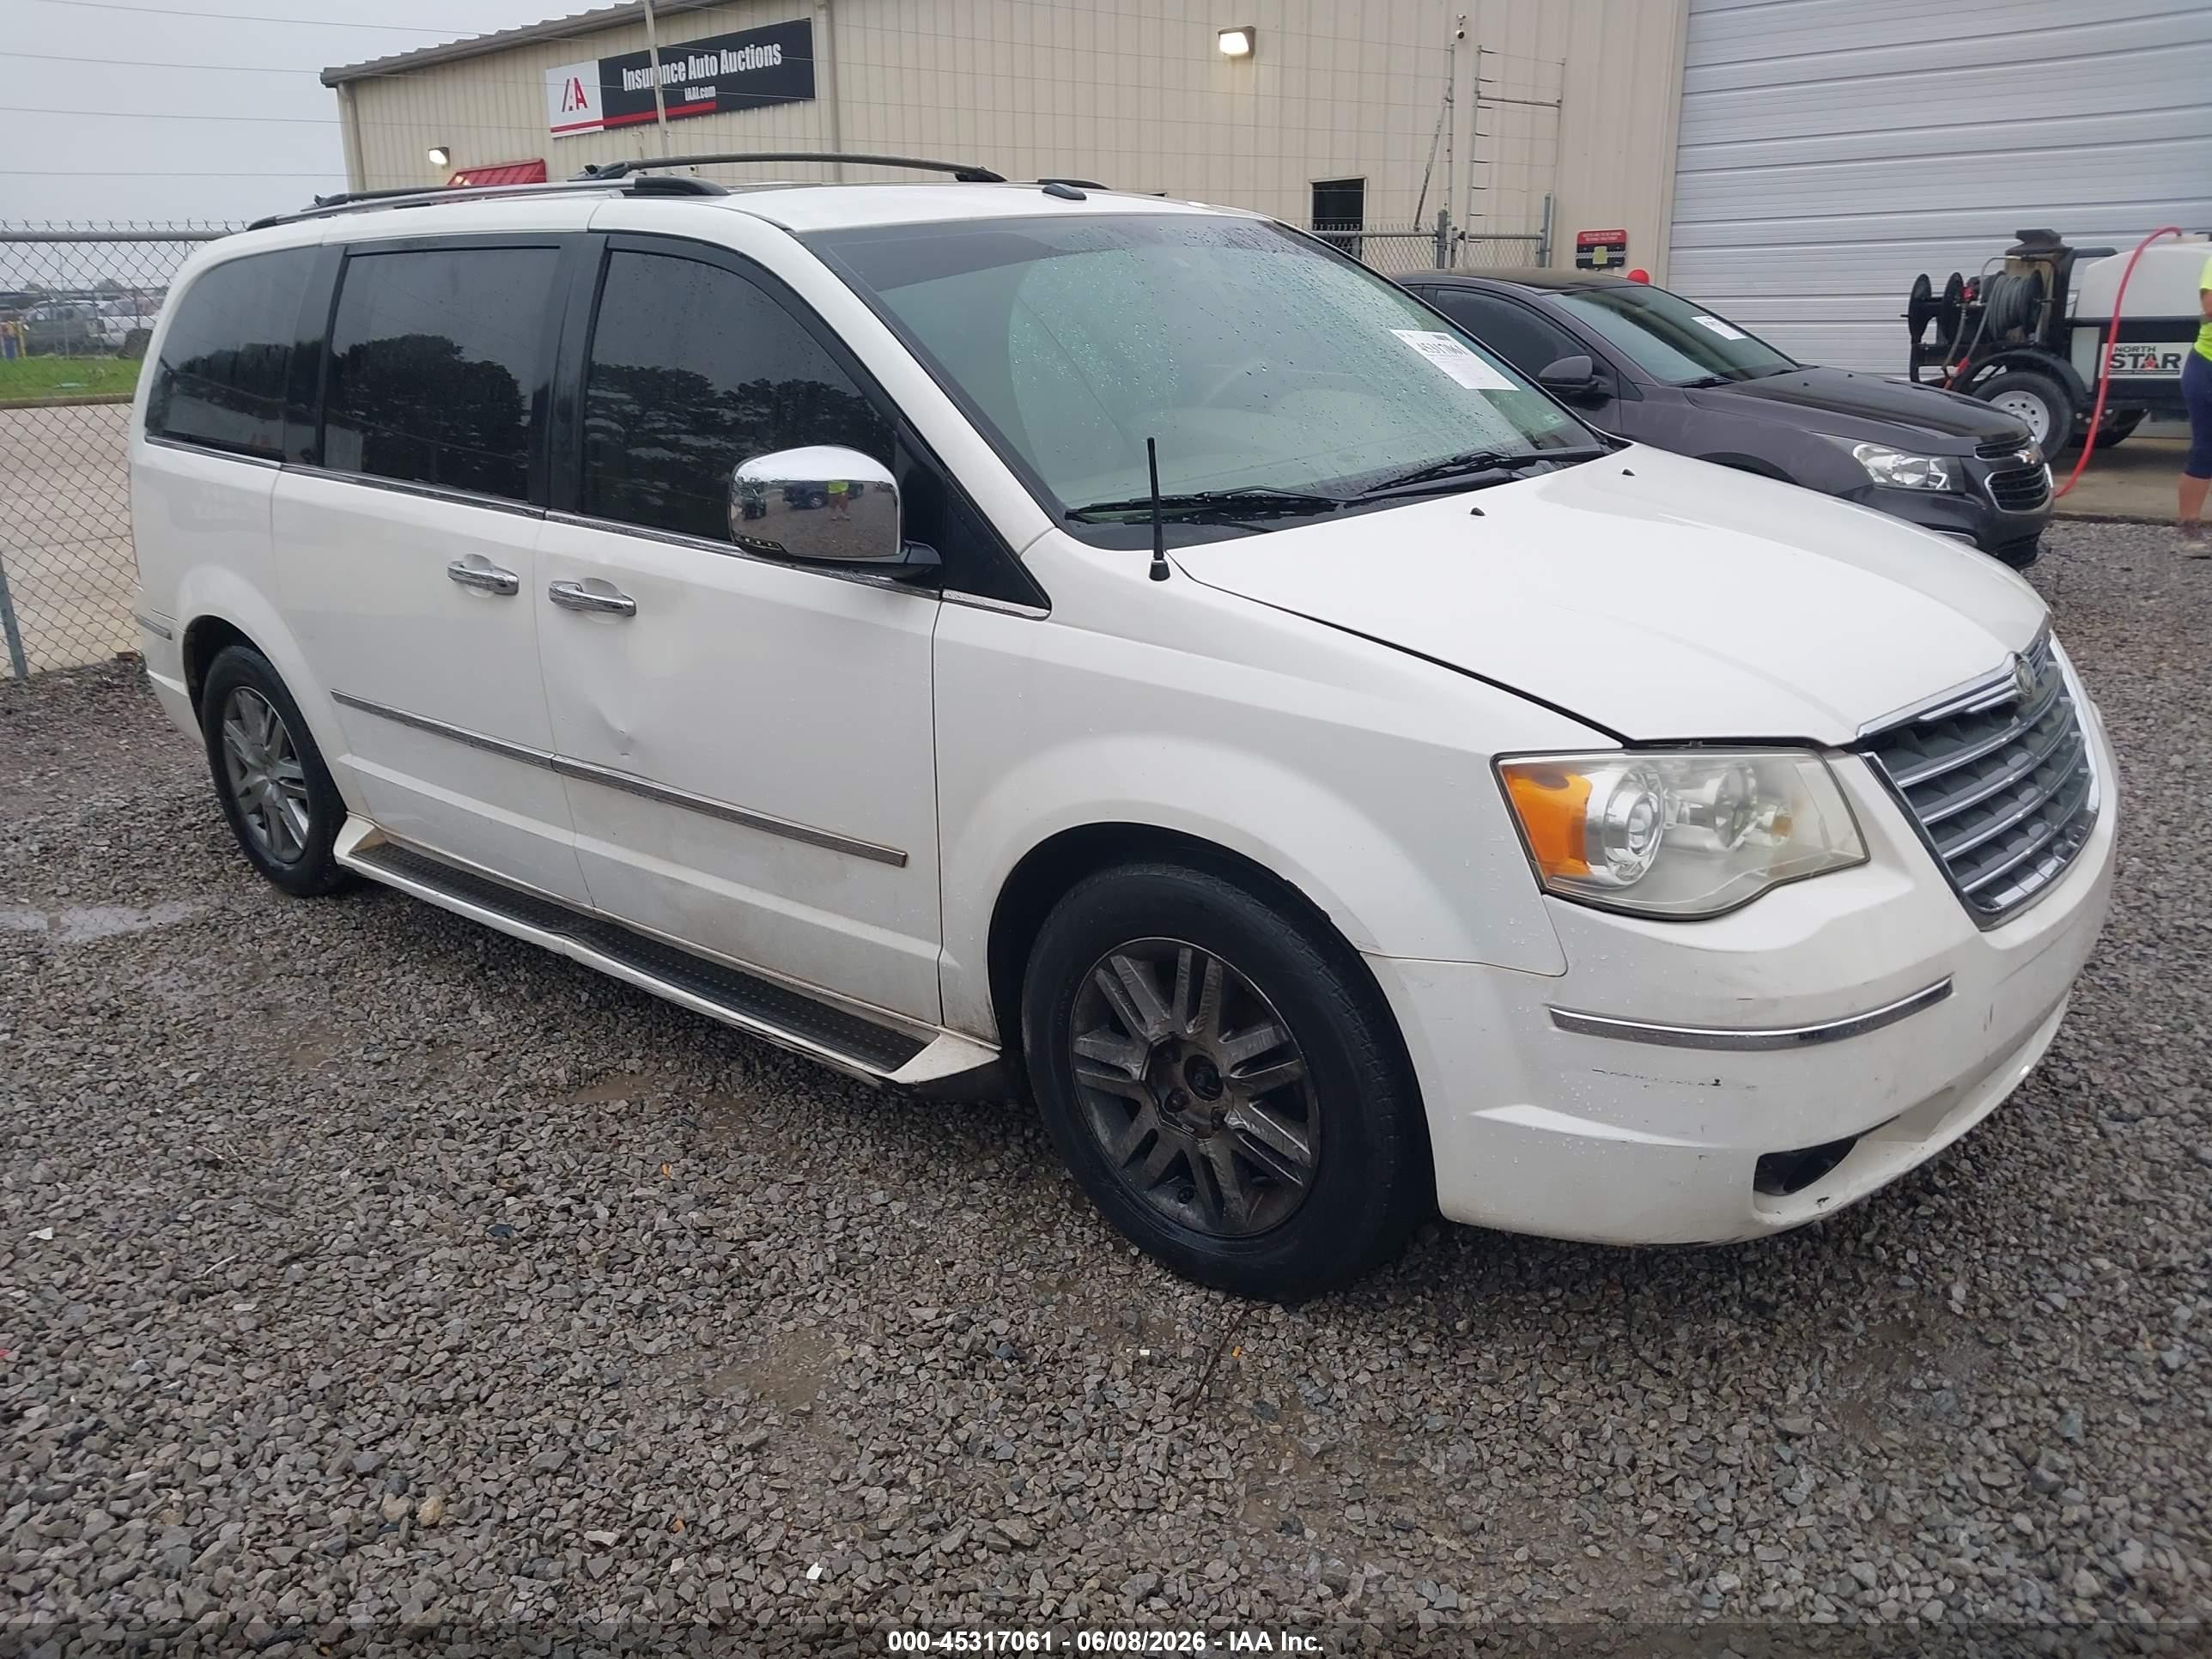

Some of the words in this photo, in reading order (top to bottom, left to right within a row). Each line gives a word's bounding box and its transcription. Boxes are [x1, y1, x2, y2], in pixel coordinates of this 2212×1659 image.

[623, 61, 686, 91] Insurnce
[688, 54, 718, 81] Auto
[720, 43, 782, 76] Auctions
[2109, 353, 2181, 369] STAR
